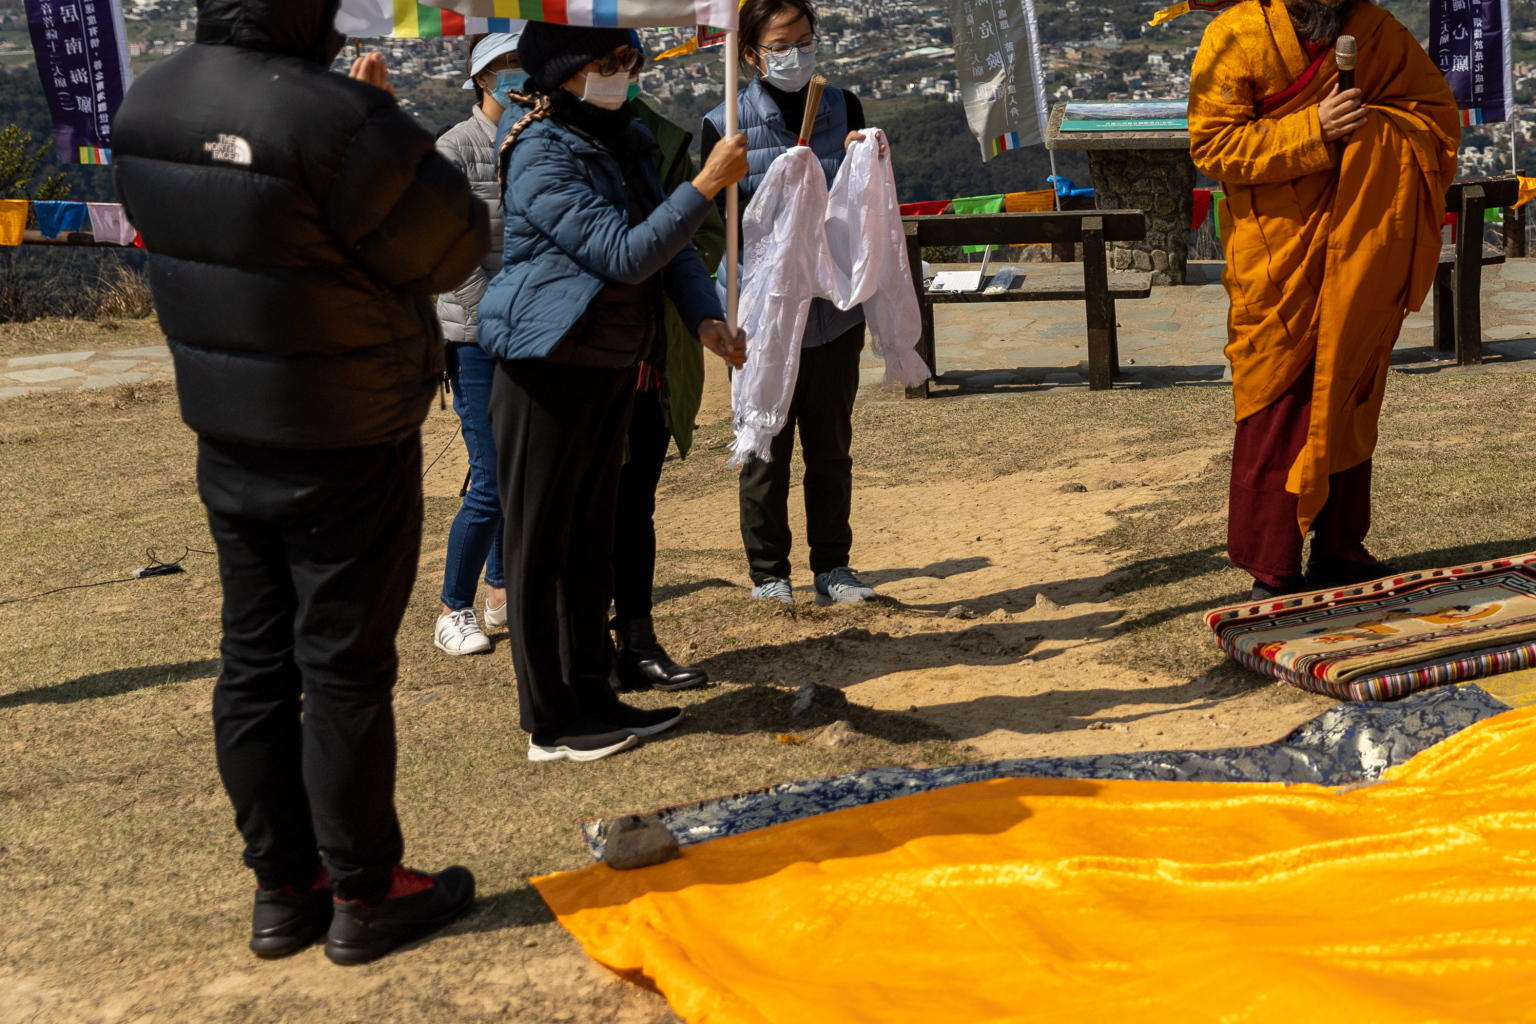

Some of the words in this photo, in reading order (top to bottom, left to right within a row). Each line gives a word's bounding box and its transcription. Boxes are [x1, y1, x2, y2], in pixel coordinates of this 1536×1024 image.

[217, 133, 236, 144] THE
[204, 141, 237, 153] NORTH
[212, 150, 236, 161] FACE
